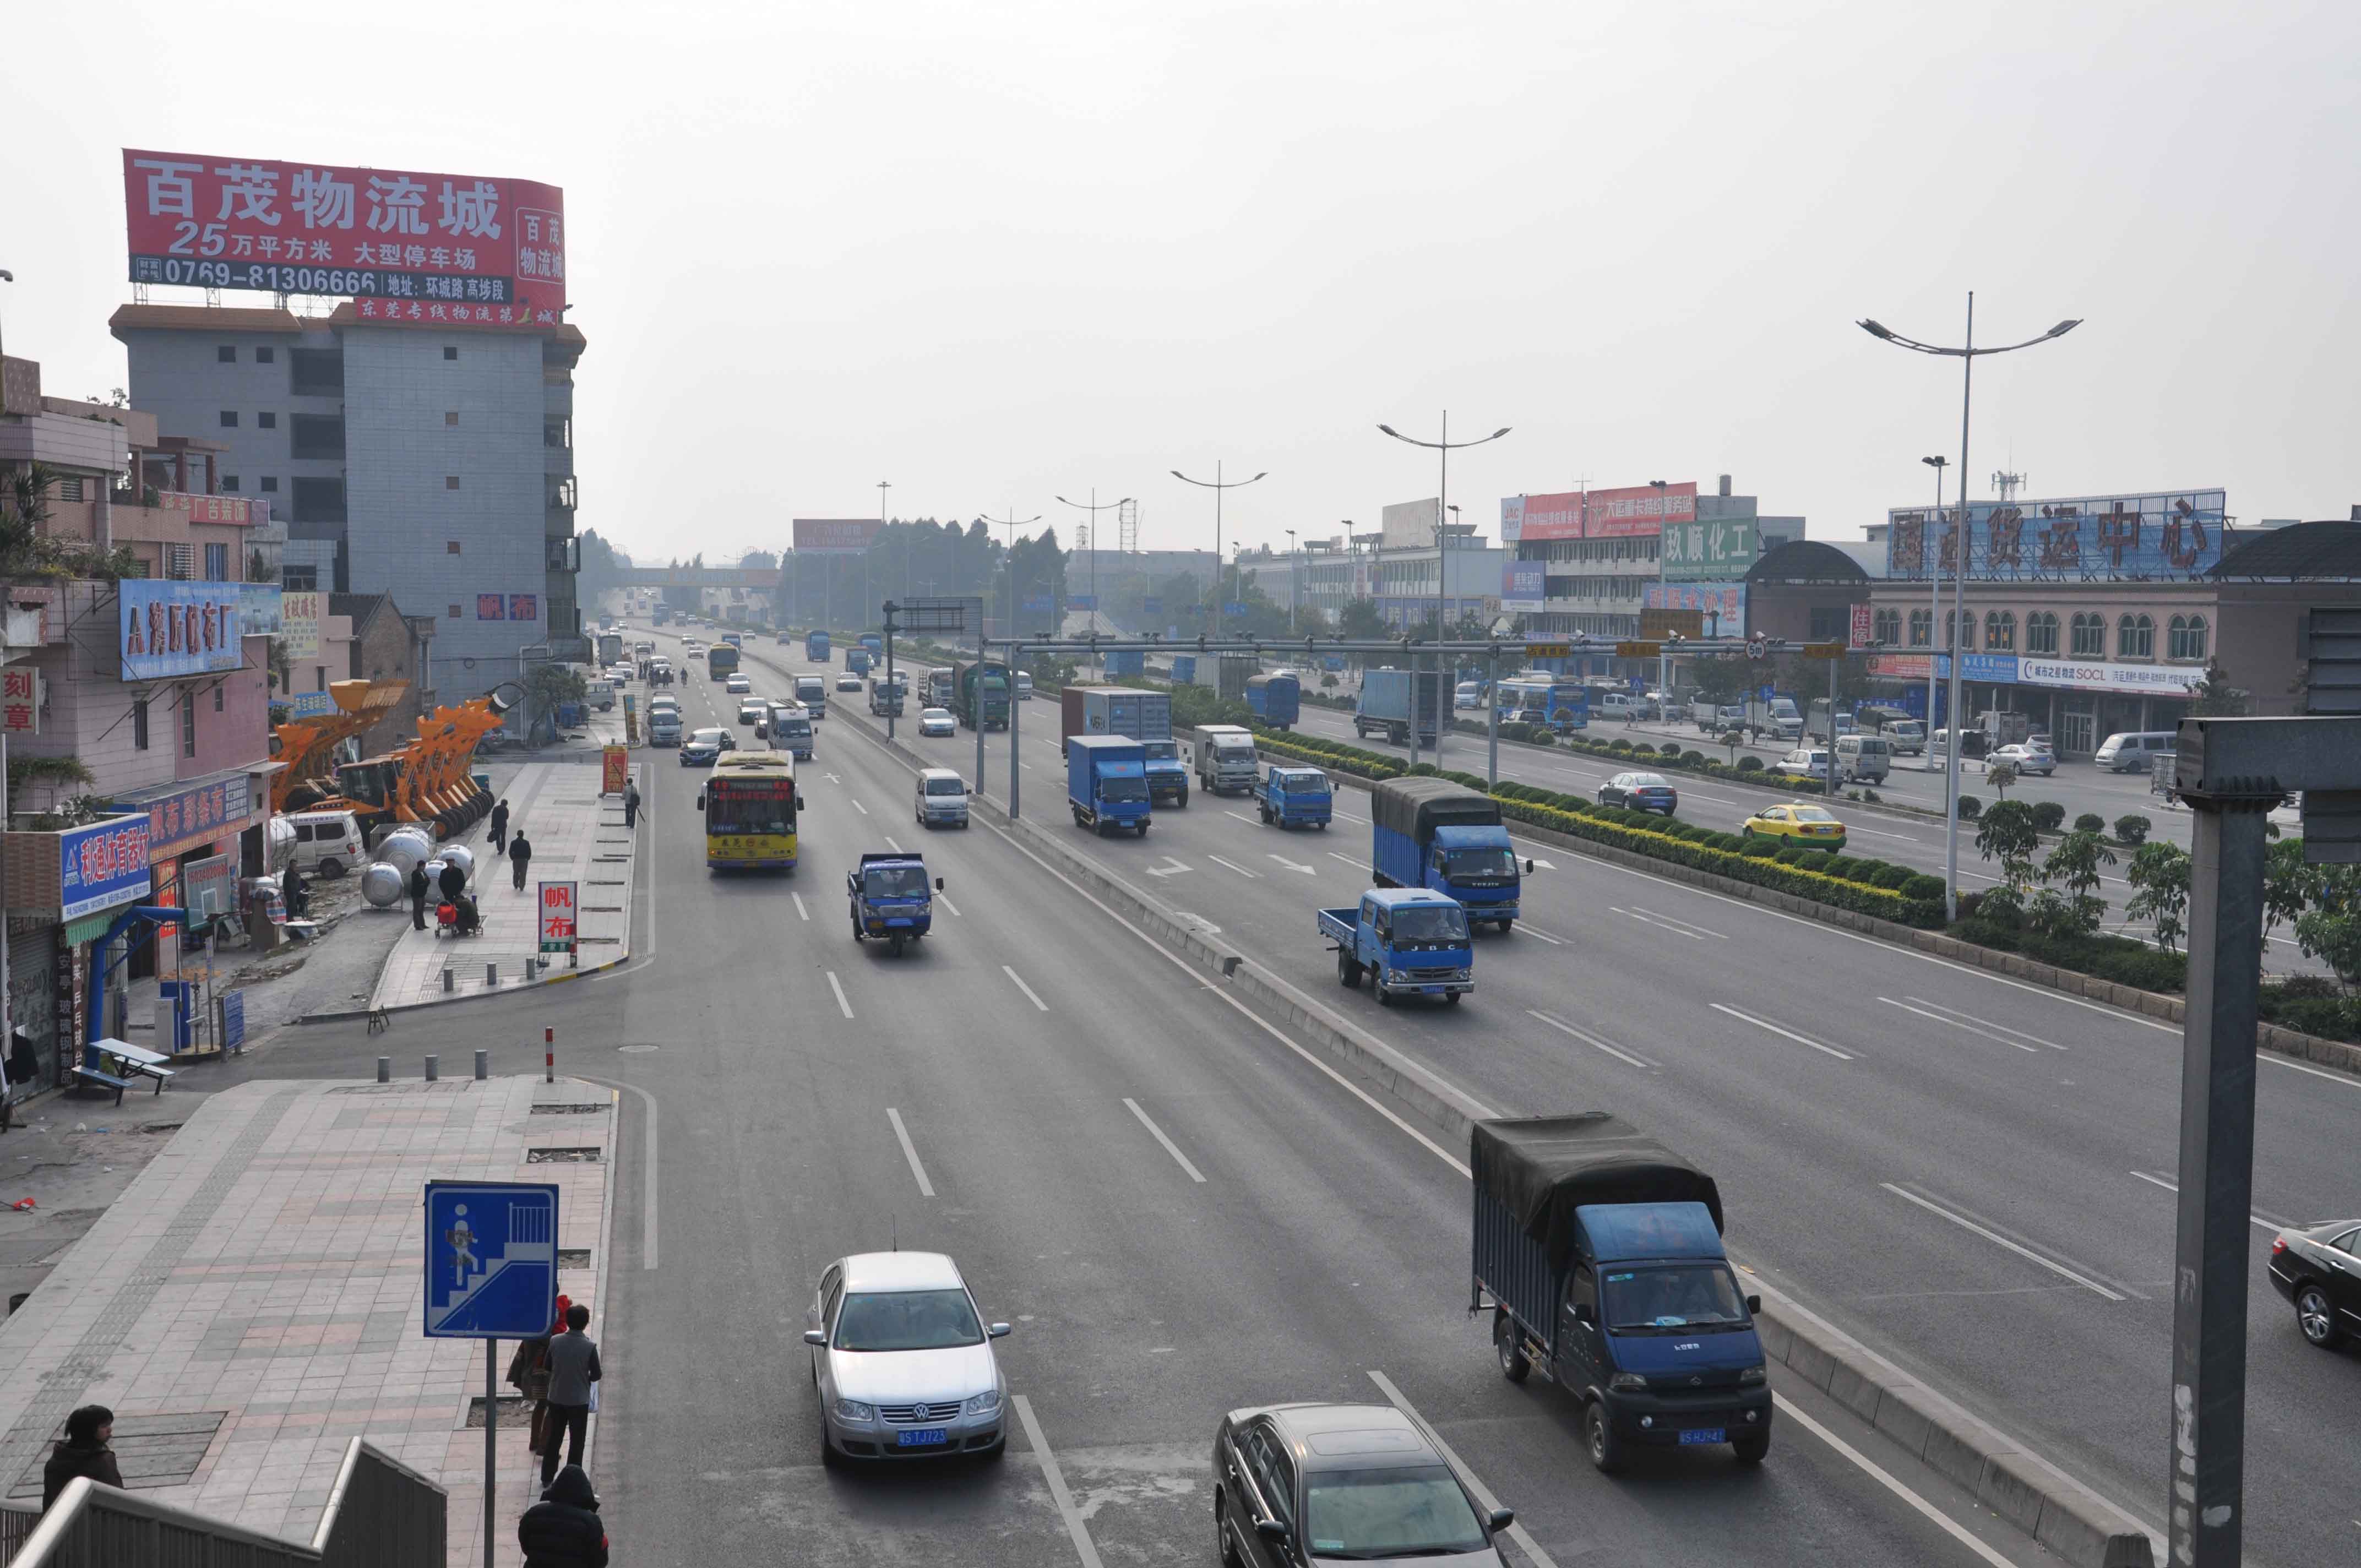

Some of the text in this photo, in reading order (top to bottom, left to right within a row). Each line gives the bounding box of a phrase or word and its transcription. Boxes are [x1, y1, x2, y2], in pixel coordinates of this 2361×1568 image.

[134, 159, 502, 240] 百茂物流城
[168, 221, 476, 270] 25万平方米 大型停车场
[524, 215, 559, 244] 百茂
[166, 259, 376, 293] 0769-81306666
[520, 247, 563, 277] 物流城
[1607, 496, 1692, 518] 大运重卡特约服务站
[1667, 523, 1749, 562] 玖顺化工
[477, 595, 536, 620] 帆布
[1853, 612, 1868, 644] 住宿
[1749, 645, 1762, 656] 5m
[2076, 668, 2106, 681] SOCL
[3, 671, 33, 731] 刻章
[81, 824, 150, 887] 利通体育器材
[545, 886, 573, 938] 帆布
[58, 999, 75, 1088] 玻璃钢制品
